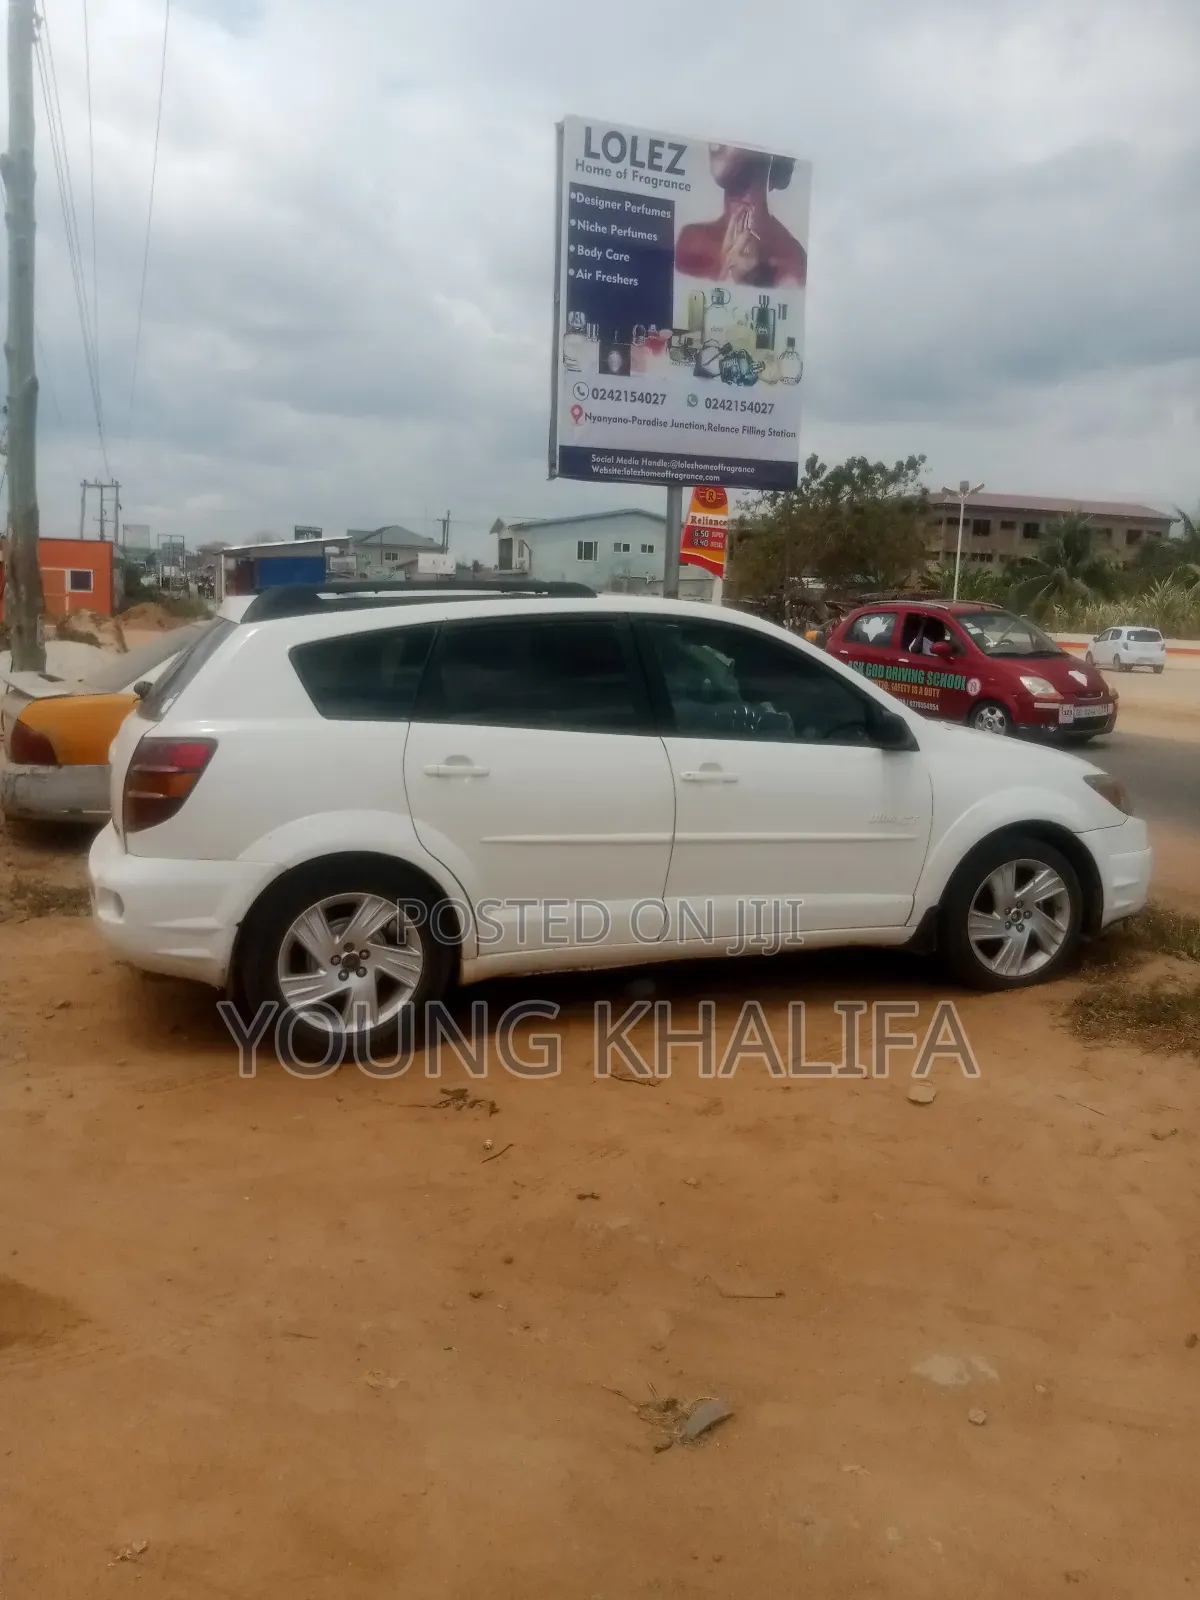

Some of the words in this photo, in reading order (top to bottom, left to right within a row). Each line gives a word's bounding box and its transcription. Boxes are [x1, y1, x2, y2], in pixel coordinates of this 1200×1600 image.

[584, 126, 688, 176] LOLEZ
[575, 158, 612, 177] Home
[616, 168, 628, 179] of
[632, 169, 691, 192] Fragrance
[576, 192, 621, 210] Designer
[625, 201, 671, 218] Perfumes
[577, 219, 607, 234] Niche
[611, 224, 658, 241] Perfumes
[577, 244, 602, 260] Body
[605, 248, 630, 262] Care
[576, 268, 592, 280] Air
[595, 270, 639, 286] Freshers
[591, 387, 667, 405] 0242154027
[705, 397, 775, 414] 0242154027
[742, 425, 766, 438] Filling
[768, 427, 796, 438] Station
[591, 454, 614, 463] Social
[616, 455, 640, 465] Media
[690, 516, 727, 526] Reliance
[866, 662, 885, 678] GOD
[886, 665, 925, 685] DRIVING
[927, 671, 966, 691] SCHOOL
[891, 682, 910, 694] SAFETY
[911, 685, 918, 695] IS
[919, 686, 923, 695] A
[924, 686, 940, 698] DUTY
